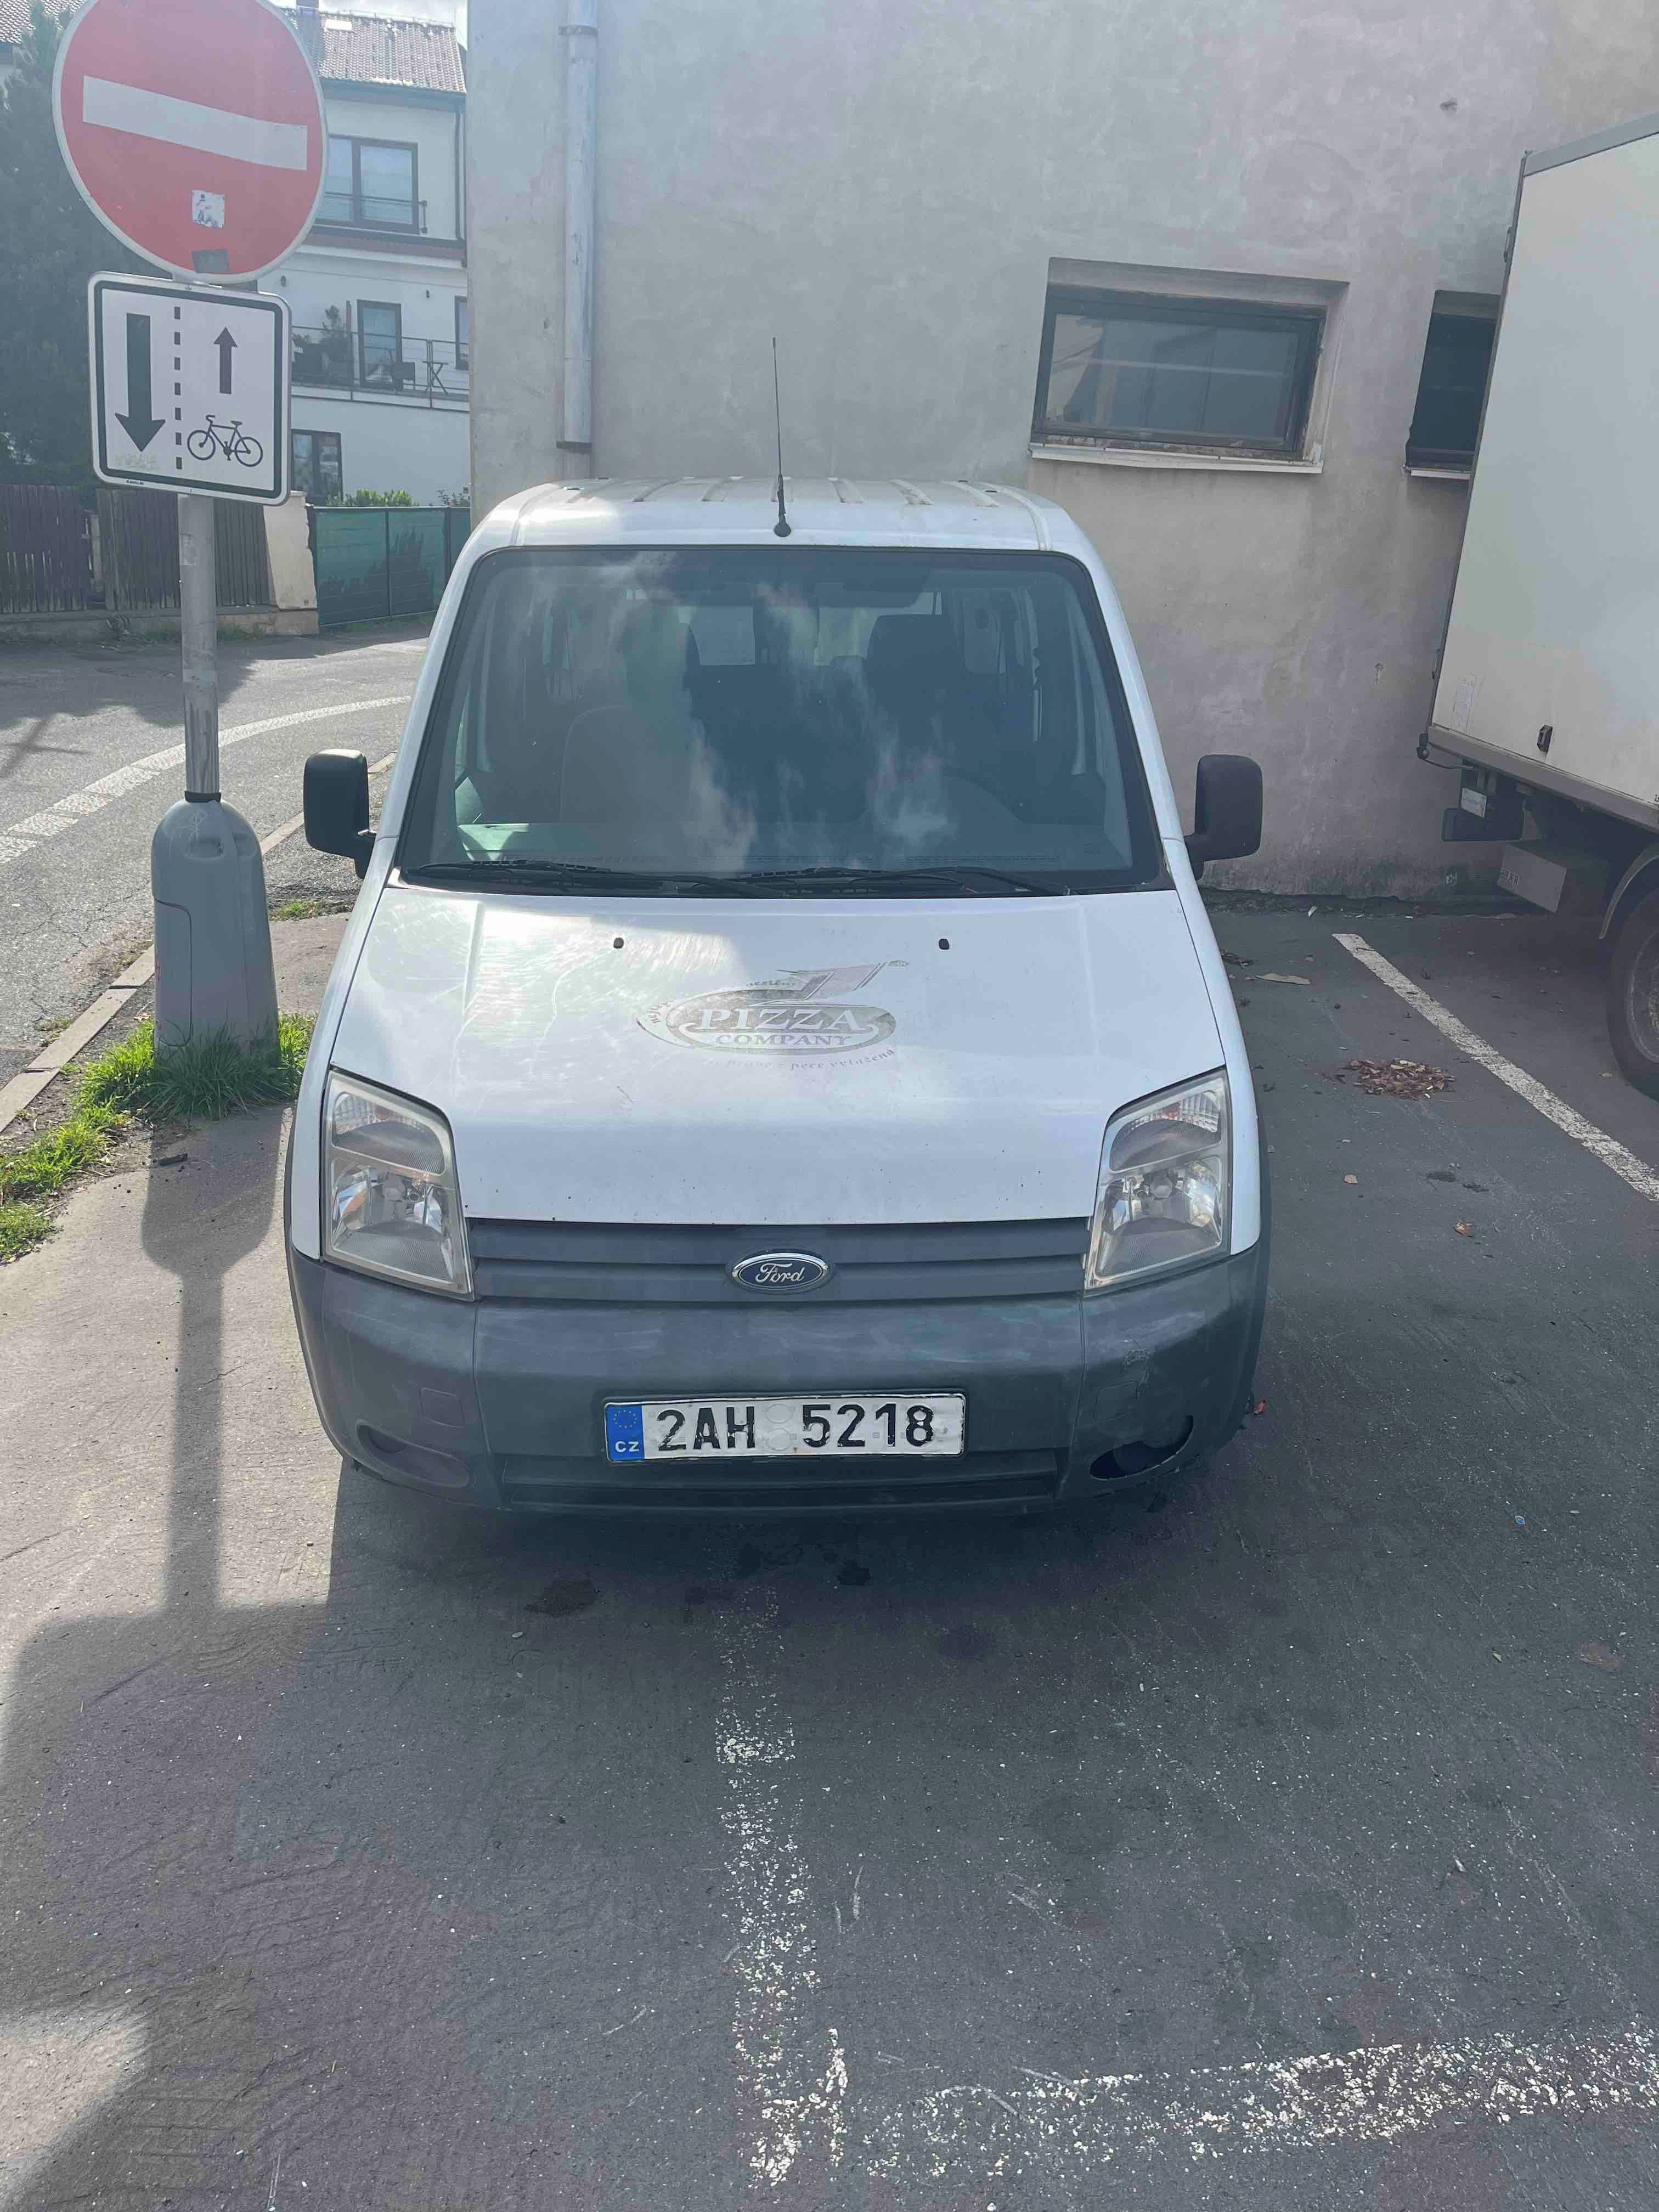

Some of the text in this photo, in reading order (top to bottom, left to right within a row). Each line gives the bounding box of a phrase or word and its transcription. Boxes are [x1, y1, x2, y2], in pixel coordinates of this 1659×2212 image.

[698, 1009, 864, 1030] PIZZA
[715, 1034, 852, 1046] COMPANY
[755, 1263, 805, 1283] Ford
[657, 1402, 934, 1451] 2AH 5218
[614, 1440, 640, 1453] CZ
